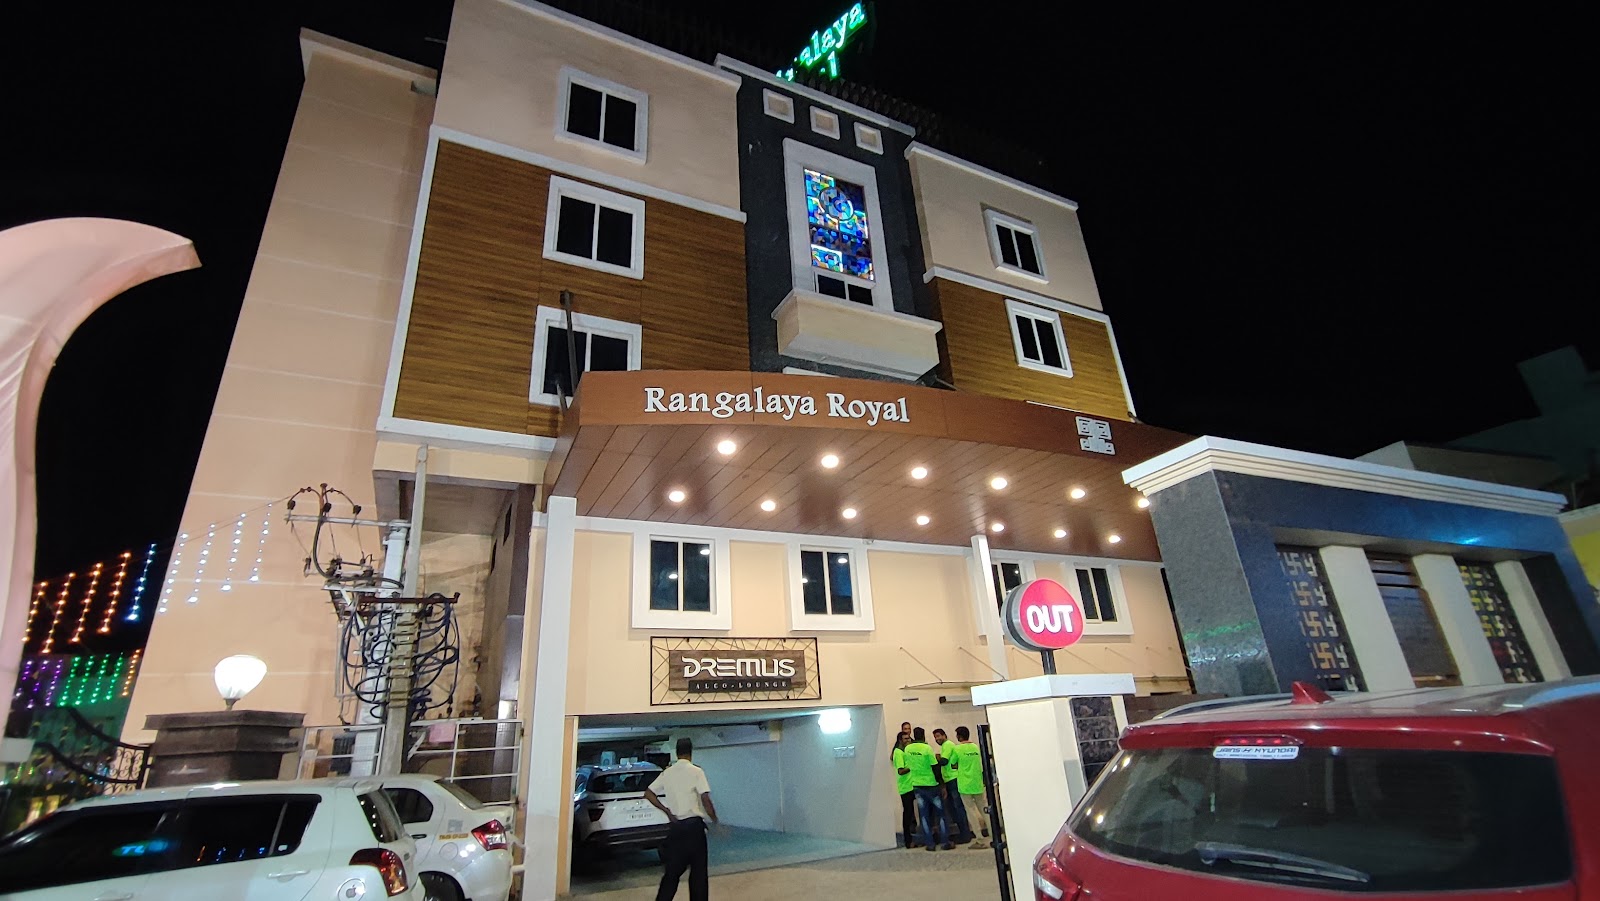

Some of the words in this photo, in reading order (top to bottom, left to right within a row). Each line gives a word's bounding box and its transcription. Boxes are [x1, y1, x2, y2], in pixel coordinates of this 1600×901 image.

[644, 386, 818, 421] Rangalaya
[826, 392, 911, 426] Royal
[1026, 604, 1074, 634] OUT
[681, 656, 796, 678] DREMUS
